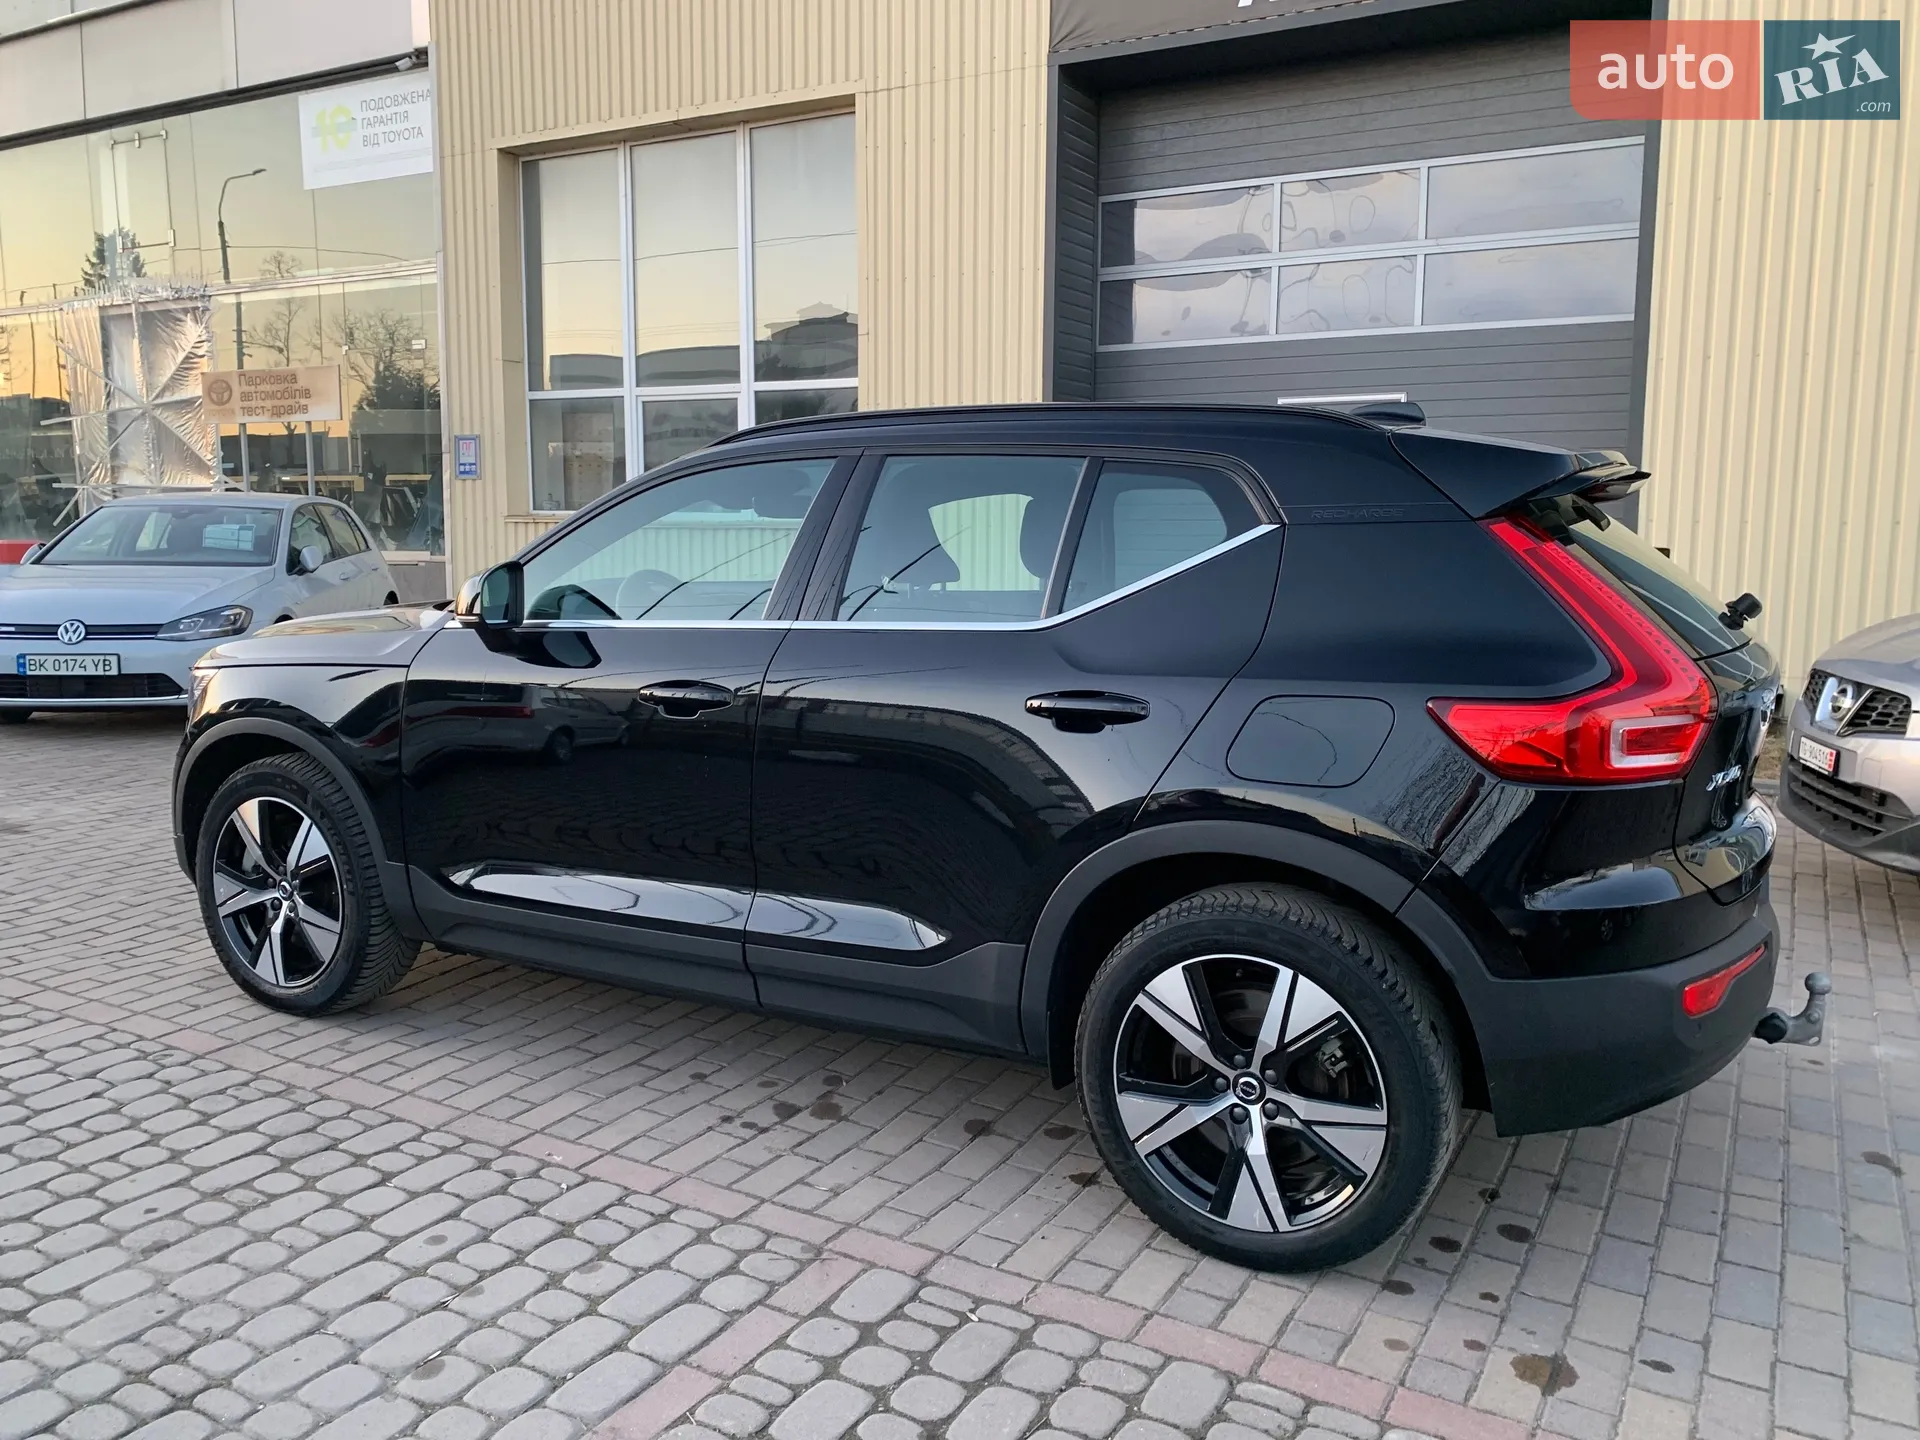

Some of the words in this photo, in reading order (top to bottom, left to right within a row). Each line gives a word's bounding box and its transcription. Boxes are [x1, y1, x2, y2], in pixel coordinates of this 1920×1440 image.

[360, 89, 431, 112] ПОДОВЖЕНА
[361, 110, 409, 130] ГАРАНТІЯ
[362, 132, 380, 148] ВІД
[383, 126, 424, 144] TOYOTA
[239, 372, 298, 389] Парковка
[240, 386, 312, 403] автомобілів
[240, 401, 309, 418] тест-драйв
[28, 658, 49, 672] BK
[53, 658, 87, 672] 0174
[91, 658, 113, 672] YB
